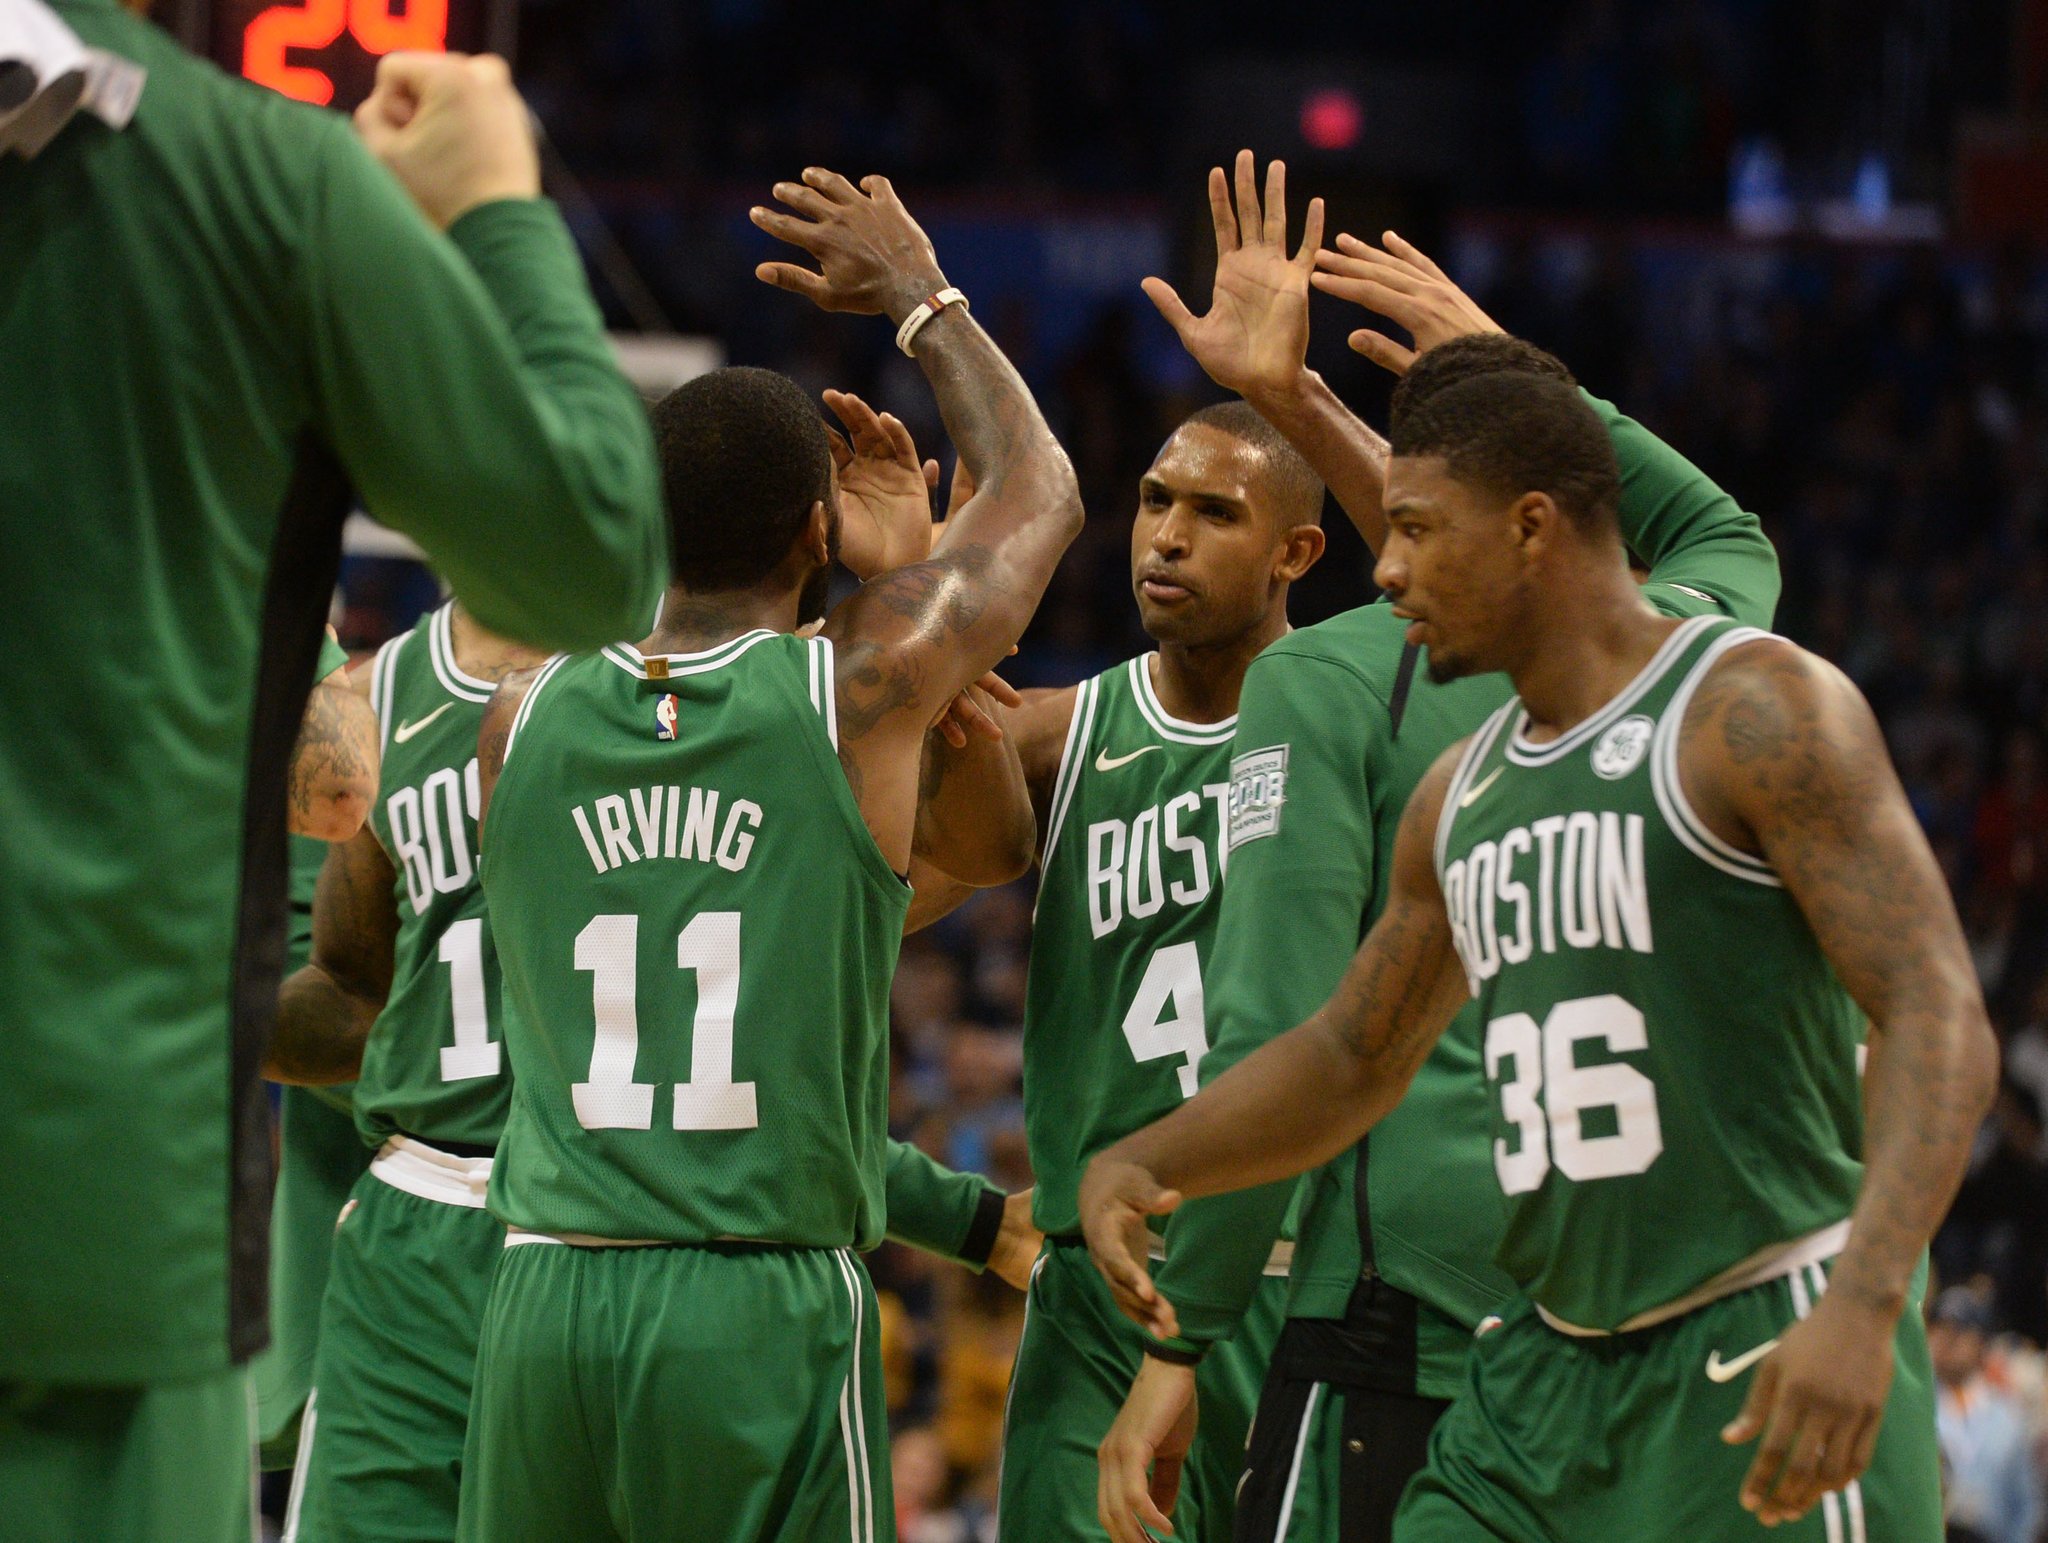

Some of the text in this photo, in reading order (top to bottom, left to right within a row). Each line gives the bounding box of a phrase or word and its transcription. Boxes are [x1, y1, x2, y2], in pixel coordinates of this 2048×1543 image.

[571, 785, 763, 874] IRVING
[1444, 811, 1653, 999] BOSTON
[571, 911, 759, 1130] 11
[1484, 994, 1663, 1196] 36
